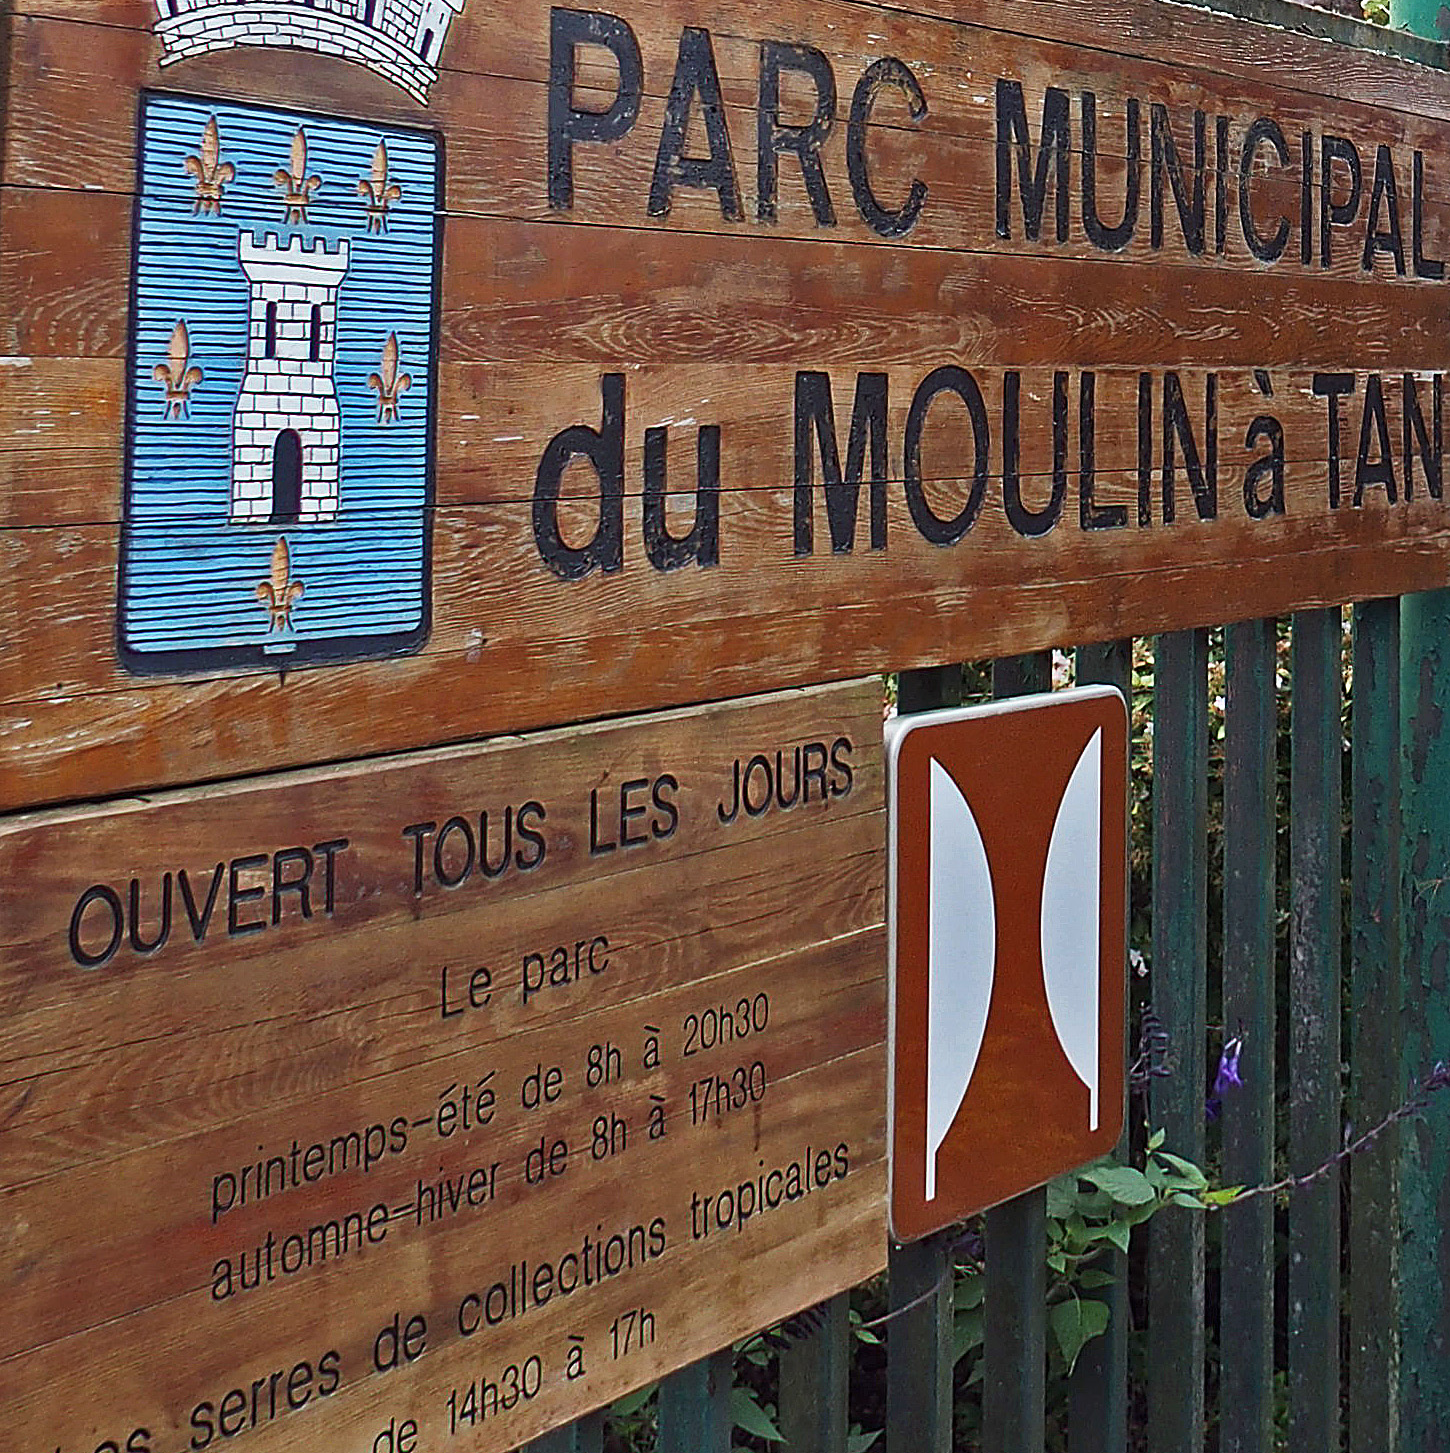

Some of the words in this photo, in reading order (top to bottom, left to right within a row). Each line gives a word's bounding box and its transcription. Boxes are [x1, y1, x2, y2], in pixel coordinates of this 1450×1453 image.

[548, 6, 928, 238] PARC
[995, 79, 1446, 279] MUNICIPAL
[531, 372, 721, 581] du
[794, 365, 1218, 556] MOULIN
[1243, 369, 1286, 521] à
[1312, 372, 1445, 511] TAN
[67, 839, 348, 968] OUVERT
[403, 802, 546, 895] TOUS
[588, 775, 679, 856] LES
[717, 736, 854, 824] JOURS
[440, 965, 492, 1019] Le
[522, 934, 610, 1004] parc
[210, 1070, 496, 1224] printemps-été
[521, 1063, 563, 1109] de
[586, 1043, 622, 1087] 8h
[643, 1025, 662, 1070] à
[683, 991, 770, 1057] 20h30
[210, 1160, 500, 1300] automne-hiver
[525, 1136, 568, 1184] de
[590, 1113, 627, 1160] 8h
[648, 1095, 667, 1140] à
[688, 1060, 767, 1127] 17h30
[189, 1349, 341, 1450] serres
[374, 1312, 428, 1372] de
[458, 1216, 667, 1336] collections
[691, 1142, 850, 1240] tropicales
[371, 1417, 418, 1453] de
[446, 1354, 542, 1435] 14h30
[566, 1334, 586, 1380] à
[609, 1307, 656, 1360] 17h
